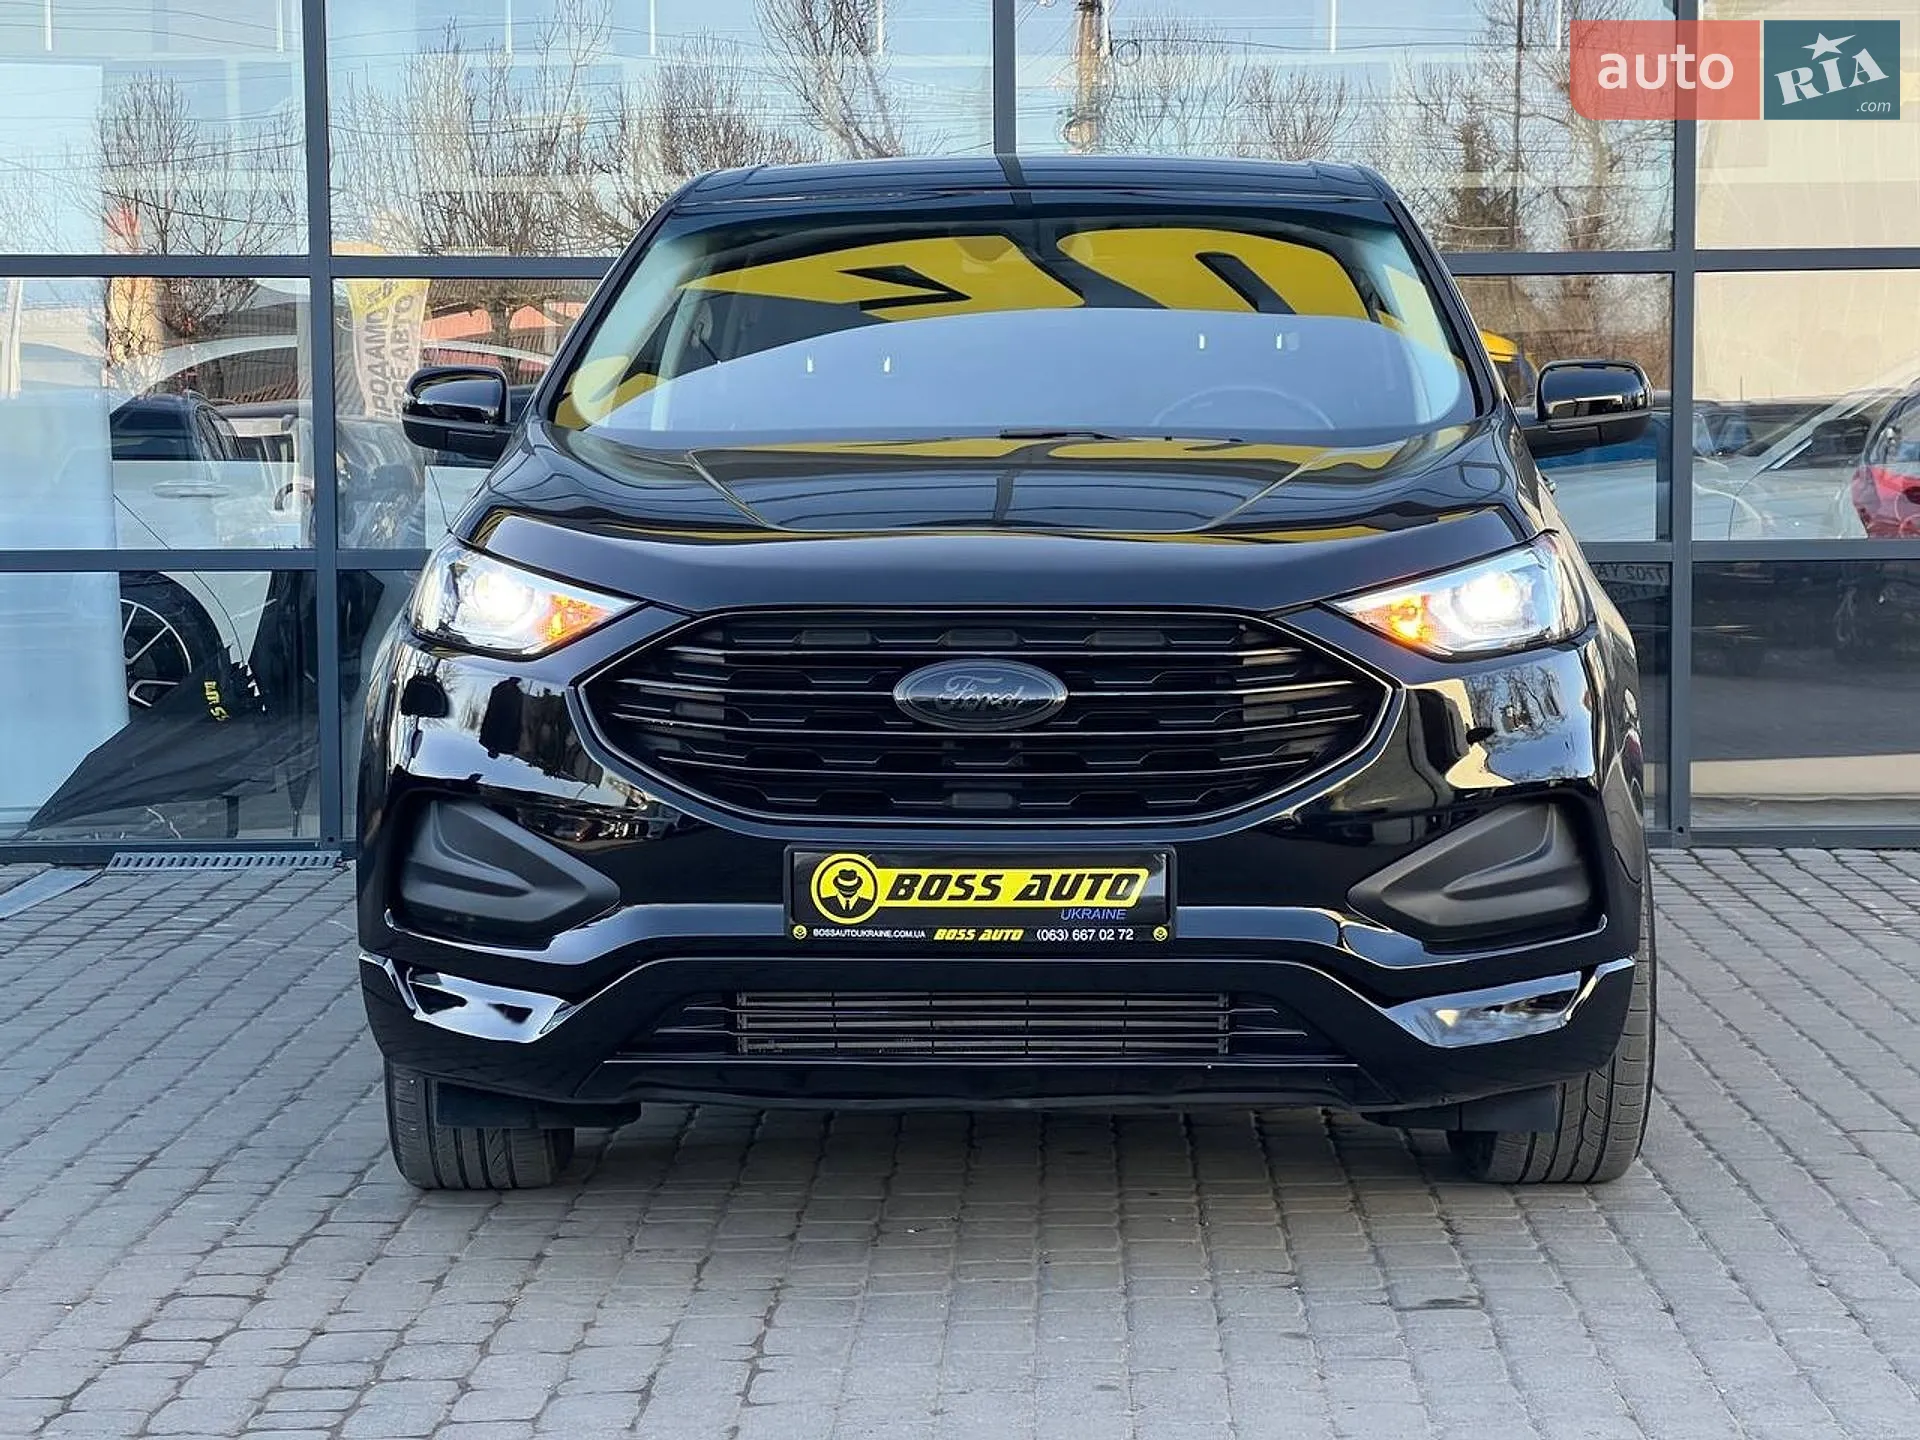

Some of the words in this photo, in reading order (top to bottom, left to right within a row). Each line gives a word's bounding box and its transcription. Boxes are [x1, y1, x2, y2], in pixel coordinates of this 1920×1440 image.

[937, 675, 1024, 712] Ford
[886, 874, 1004, 901] BOSS
[1014, 874, 1141, 901] AUTO
[1061, 909, 1128, 920] UKRAINE
[812, 928, 926, 939] BOSSAUTOUKRAINE.COM.UA
[934, 928, 976, 941] BOSS
[978, 928, 1025, 941] AUTO
[1036, 928, 1069, 941] (063)
[1072, 929, 1095, 941] 667
[1099, 929, 1115, 941] 02
[1118, 929, 1134, 941] 72
